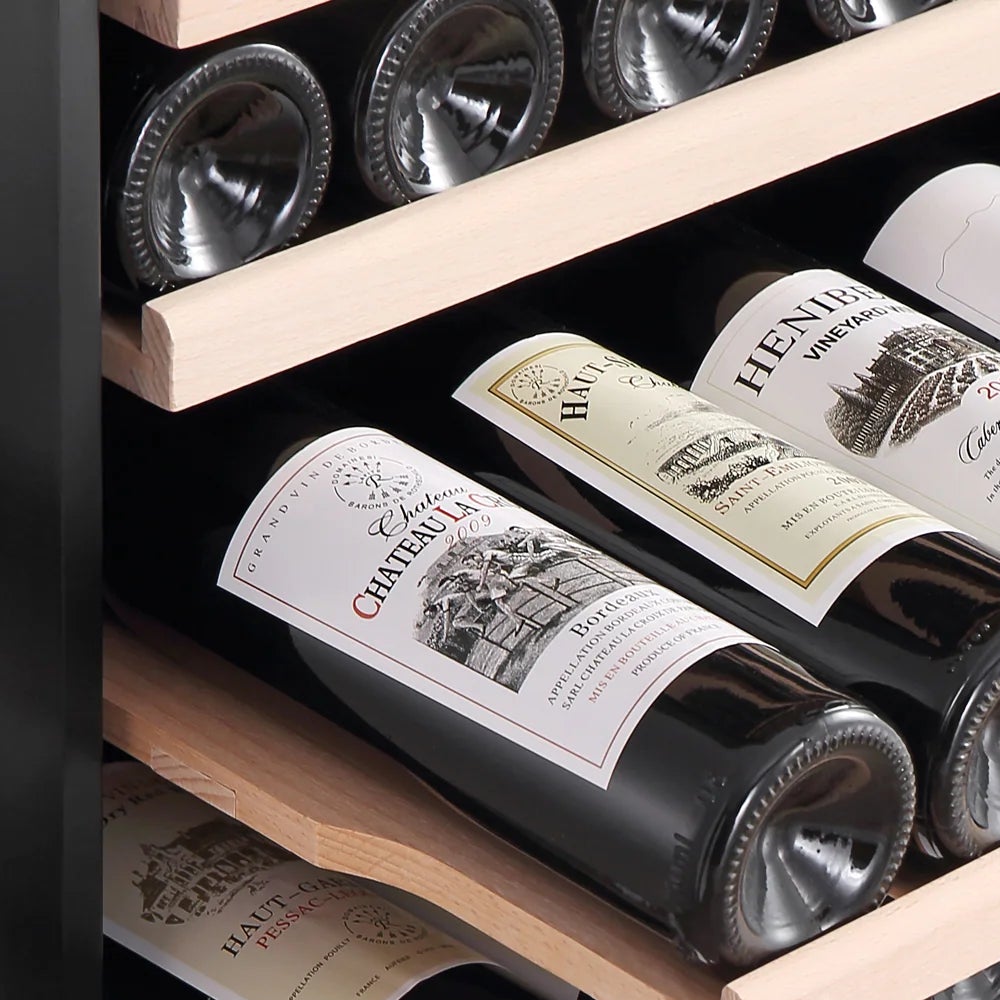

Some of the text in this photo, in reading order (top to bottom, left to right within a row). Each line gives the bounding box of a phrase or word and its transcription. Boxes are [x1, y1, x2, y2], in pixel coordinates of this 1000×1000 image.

[803, 306, 888, 362] VINEYARD
[984, 466, 996, 480] The
[247, 504, 289, 573] GRAND
[290, 471, 320, 499] VIN
[322, 453, 345, 469] DE
[348, 496, 406, 510] BARONS DE
[367, 486, 469, 542] Chateau
[743, 475, 799, 515] APPELLATION
[986, 493, 995, 503] In
[444, 513, 492, 549] 2009
[781, 512, 804, 531] MIS
[802, 502, 819, 514] EN
[352, 516, 447, 620] CHATEAU
[432, 501, 481, 522] LA
[569, 589, 661, 639] Bordeaux
[547, 599, 661, 707] APPELLATION BORDEAUX
[561, 680, 584, 711] SARL
[580, 637, 622, 681] CHATEAU
[620, 627, 636, 639] LA
[633, 609, 665, 630] CROIX
[588, 681, 608, 704] MIS
[605, 664, 621, 681] EN
[618, 622, 677, 666] BOUTEILLE
[631, 640, 675, 677] PRODUCE
[323, 938, 351, 962] POUILLY
[356, 974, 380, 997] FRANCE
